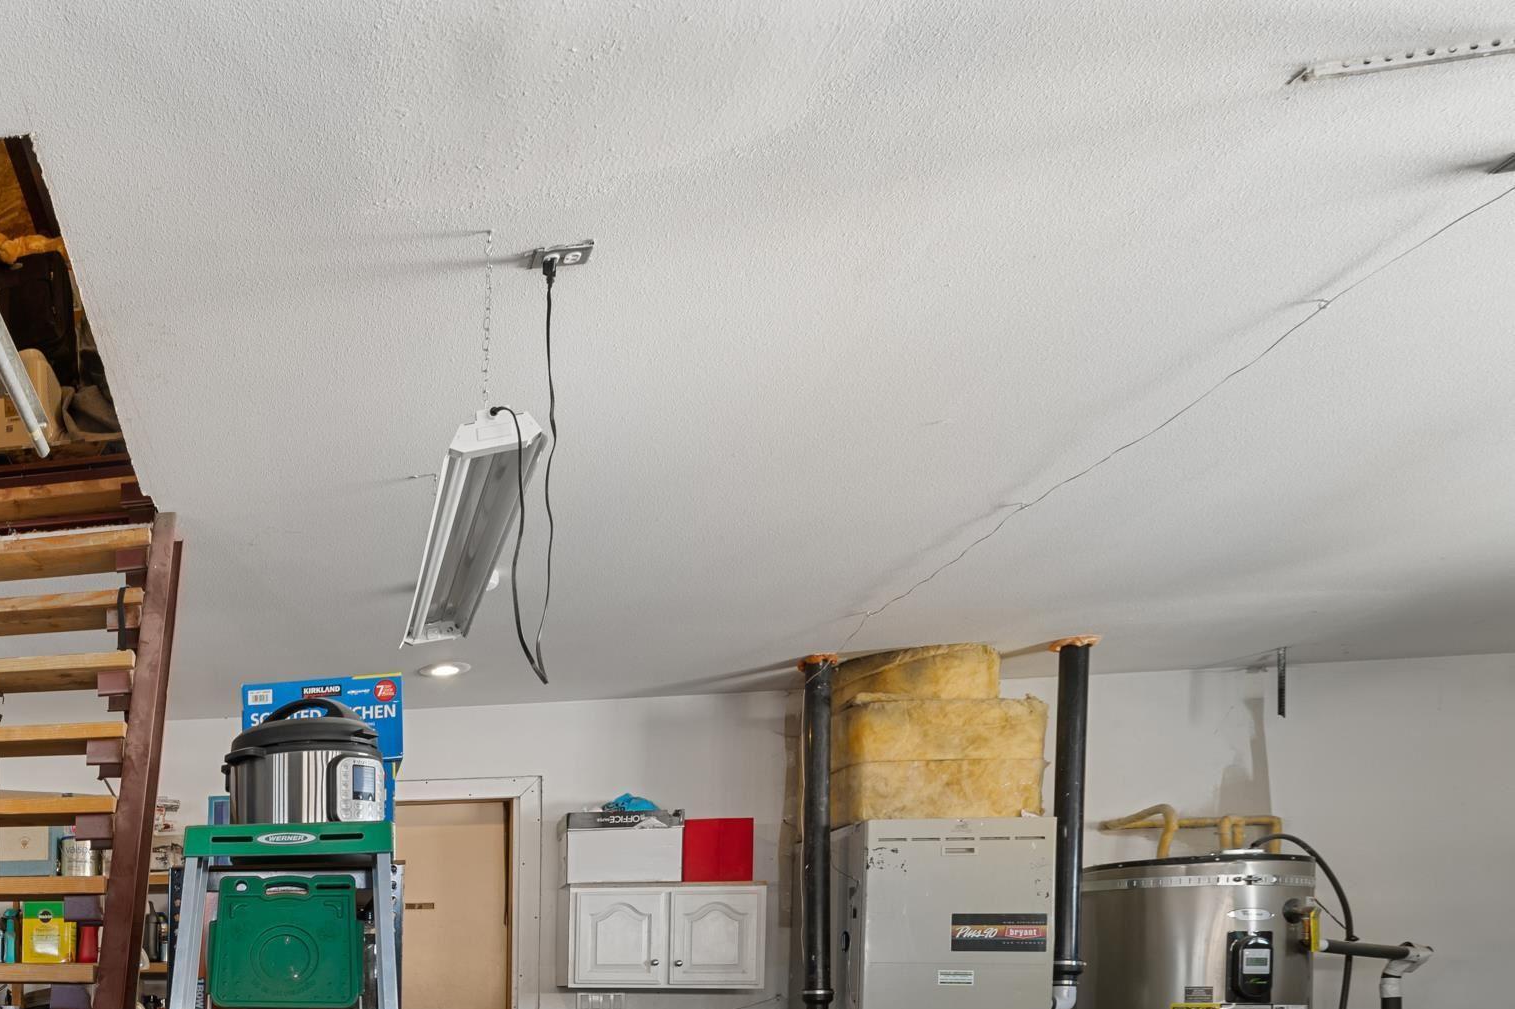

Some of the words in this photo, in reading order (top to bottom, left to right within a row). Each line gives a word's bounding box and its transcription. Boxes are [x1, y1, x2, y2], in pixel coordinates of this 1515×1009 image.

[303, 685, 341, 695] KIRKLAND
[250, 708, 322, 727] SCTED
[352, 703, 396, 720] CHEN
[1009, 928, 1037, 937] bryant
